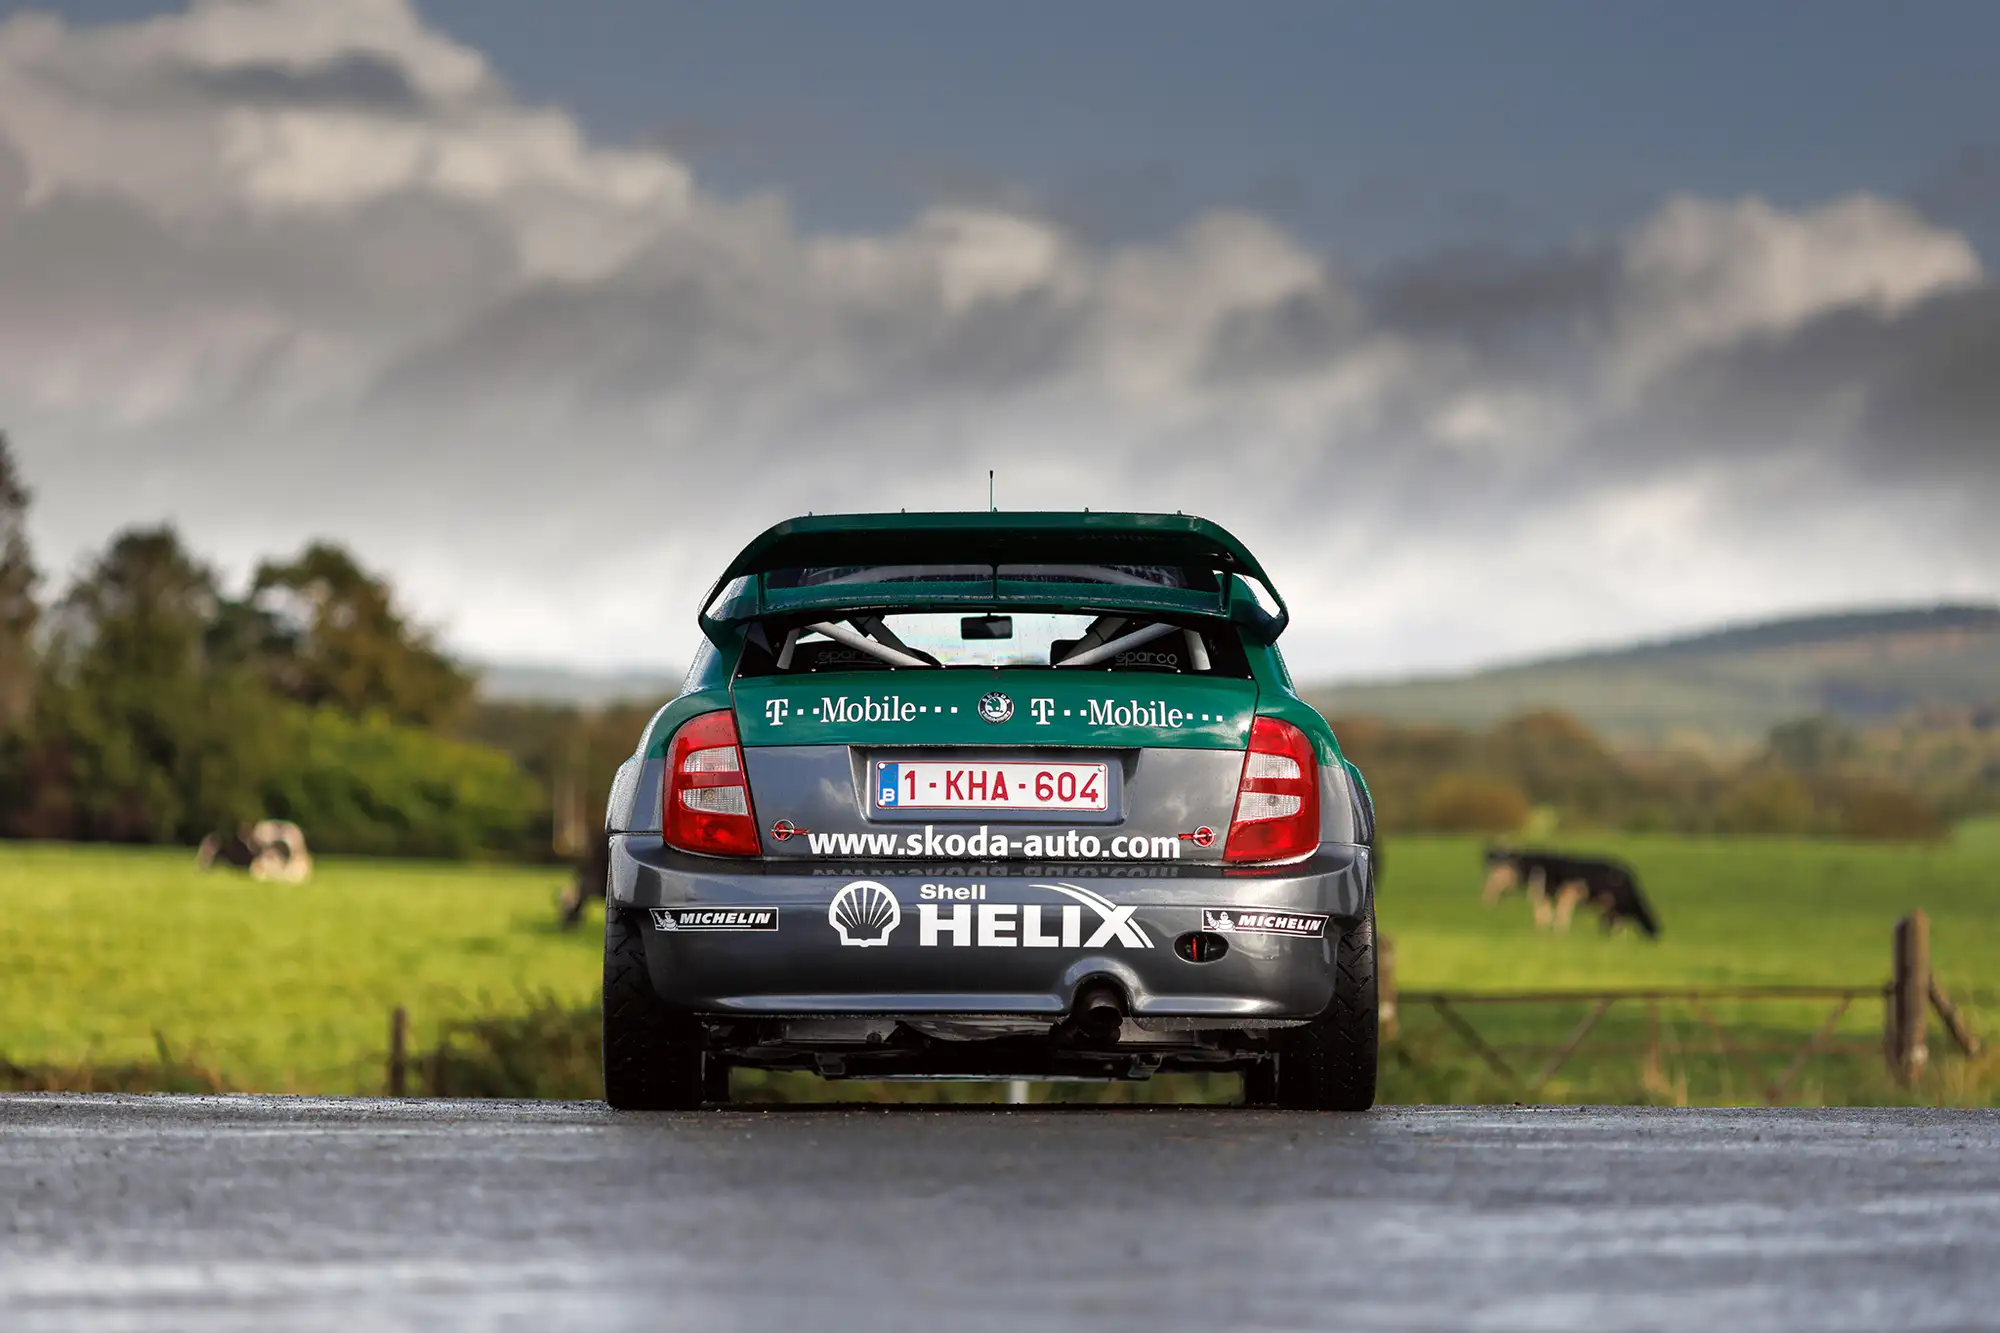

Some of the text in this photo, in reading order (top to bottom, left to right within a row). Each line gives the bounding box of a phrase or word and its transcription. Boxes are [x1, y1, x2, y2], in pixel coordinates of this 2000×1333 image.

[817, 650, 876, 665] sparc
[1115, 651, 1178, 667] sparco
[882, 788, 896, 802] B
[808, 825, 1181, 859] www.skoda-auto.com
[920, 884, 986, 900] Shell
[680, 912, 772, 925] MICHELIN
[916, 883, 1155, 949] HELIX
[1239, 914, 1323, 932] MICHELIN
